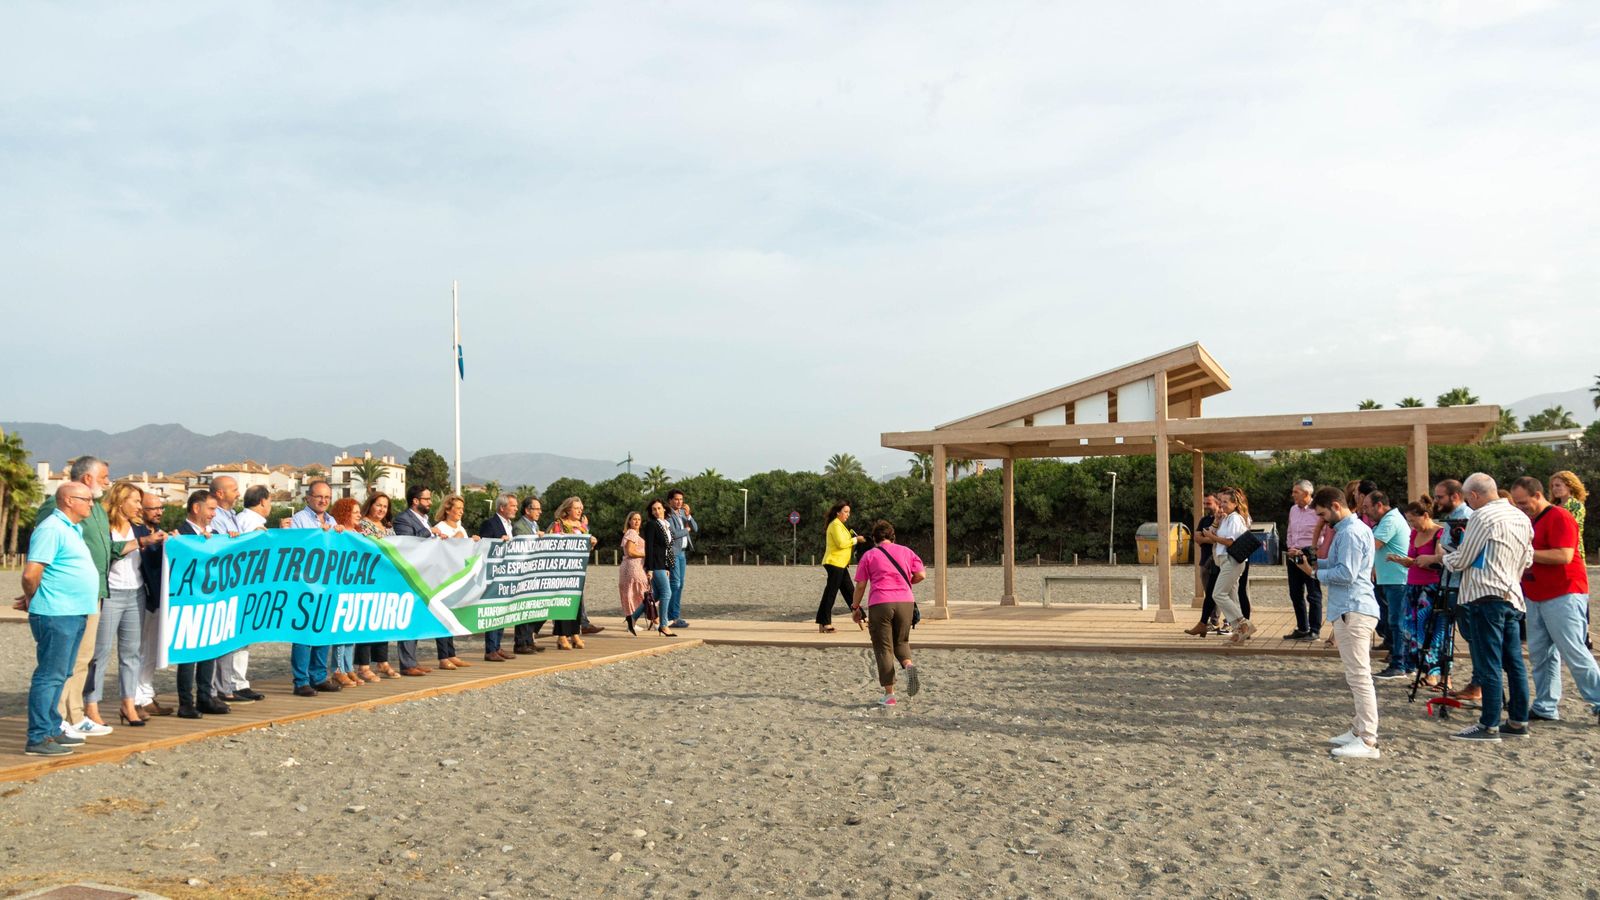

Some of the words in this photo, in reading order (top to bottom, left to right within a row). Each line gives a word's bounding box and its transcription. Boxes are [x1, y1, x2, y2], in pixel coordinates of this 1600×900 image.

[556, 539, 567, 551] DE
[565, 538, 588, 551] RULES.
[201, 548, 271, 595] COSTA
[272, 547, 382, 586] TROPICAL
[545, 558, 559, 570] LAS
[558, 558, 583, 570] PLAYAS.
[498, 583, 509, 596] Por
[510, 582, 517, 595] la
[540, 577, 580, 590] FERROVIARIA
[240, 590, 288, 634] POR
[291, 591, 333, 634] SU
[331, 591, 415, 634] FUTURO
